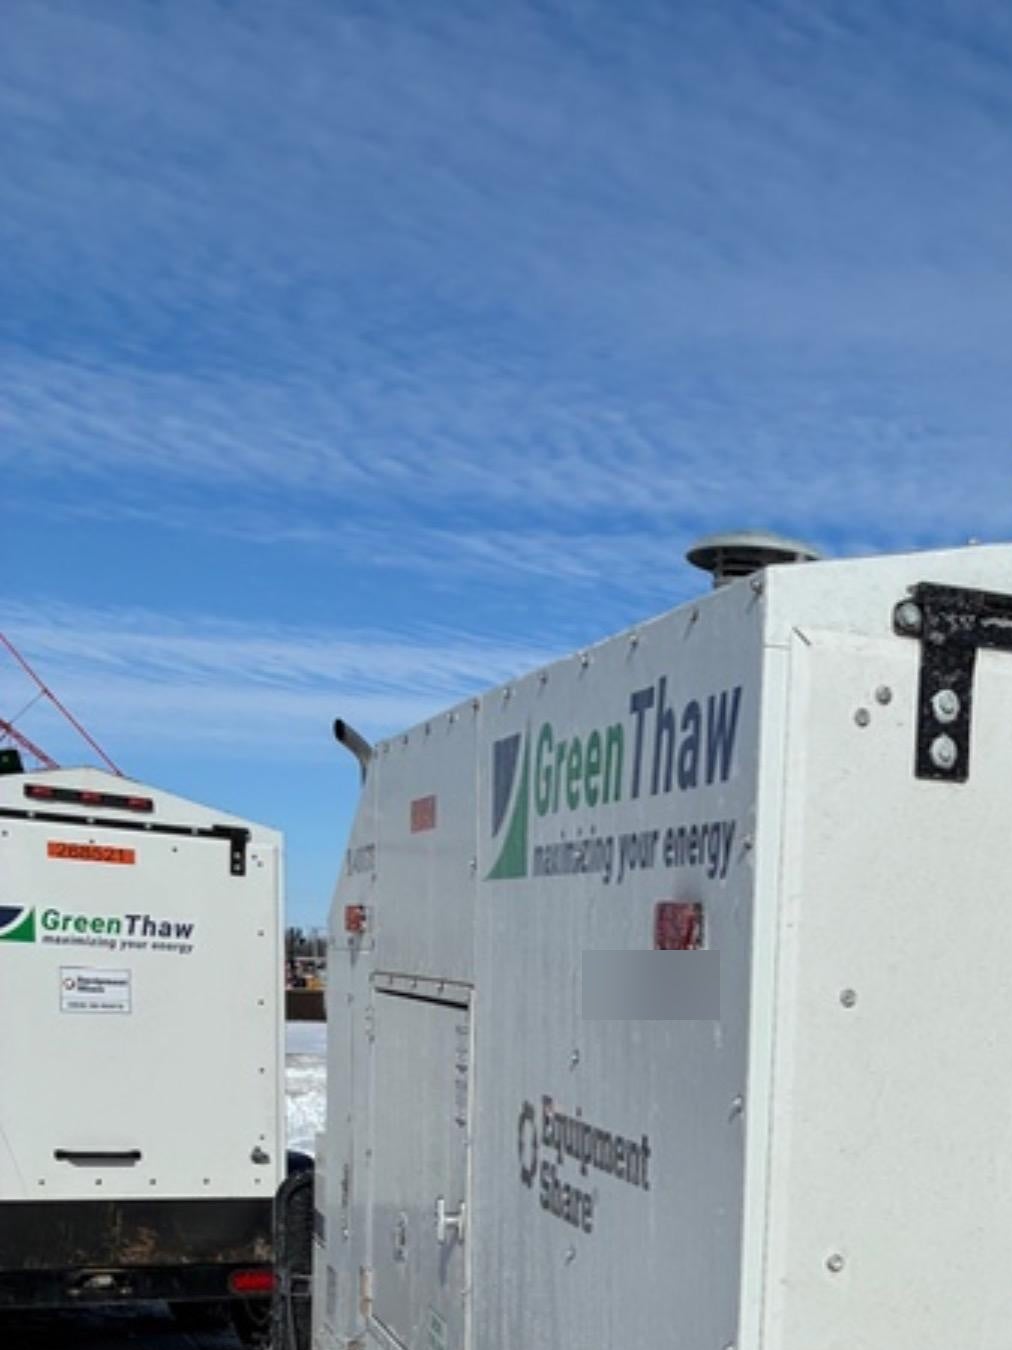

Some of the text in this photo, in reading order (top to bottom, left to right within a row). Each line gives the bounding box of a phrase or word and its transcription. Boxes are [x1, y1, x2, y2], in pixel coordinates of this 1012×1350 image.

[534, 676, 742, 817] GreenThaw
[532, 819, 736, 885] maximizing your energy
[41, 908, 194, 939] GreenThaw
[543, 1094, 651, 1191] Equipment
[540, 1160, 593, 1234] Share
